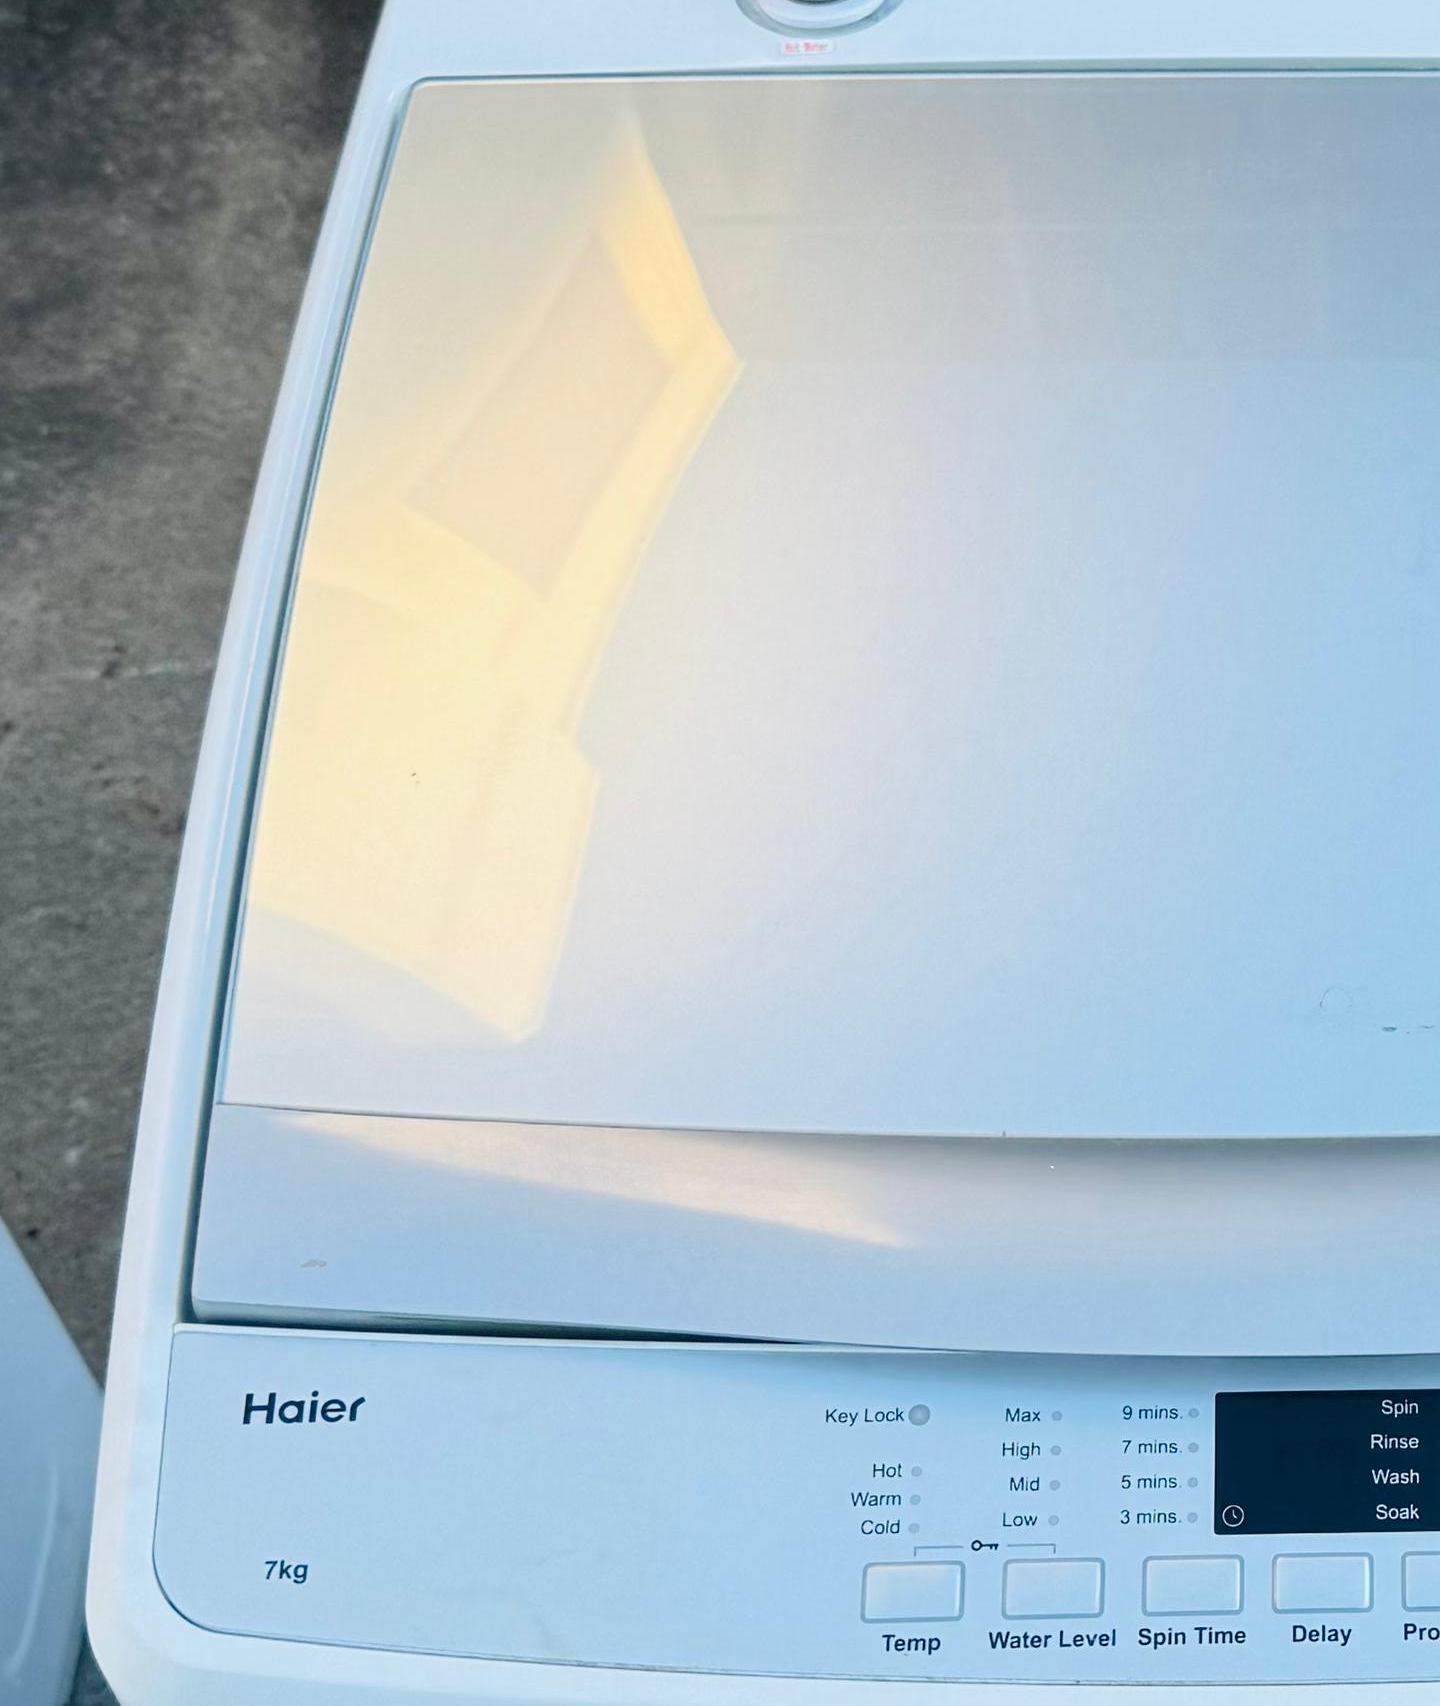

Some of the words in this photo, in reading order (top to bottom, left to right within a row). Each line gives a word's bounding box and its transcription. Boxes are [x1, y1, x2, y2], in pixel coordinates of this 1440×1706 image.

[242, 1390, 366, 1425] Haier
[1005, 1407, 1041, 1423] Max
[1122, 1404, 1133, 1421] 9
[1137, 1404, 1184, 1421] mins.
[1381, 1399, 1419, 1419] Spin
[825, 1408, 859, 1427] Key
[864, 1407, 905, 1423] Lock
[1122, 1439, 1132, 1454] 7
[1137, 1438, 1184, 1455] mins.
[1370, 1433, 1420, 1450] Rinse
[1002, 1441, 1041, 1461] High
[872, 1463, 903, 1478] Hot
[1371, 1468, 1420, 1485] Wash
[1009, 1476, 1040, 1492] Mid
[1121, 1474, 1132, 1490] 5
[1137, 1473, 1183, 1489] mins.
[850, 1491, 902, 1507] Warm
[1002, 1512, 1038, 1528] Low
[1120, 1509, 1131, 1525] 3
[1136, 1509, 1182, 1525] mins.
[1375, 1503, 1420, 1520] Soak
[860, 1519, 901, 1535] Cold
[264, 1559, 309, 1585] 7kg
[988, 1630, 1053, 1650] Water
[1059, 1628, 1117, 1648] Level
[1137, 1626, 1187, 1651] Spin
[1193, 1626, 1247, 1645] Time
[1292, 1624, 1353, 1647] Delay
[881, 1634, 941, 1656] Temp
